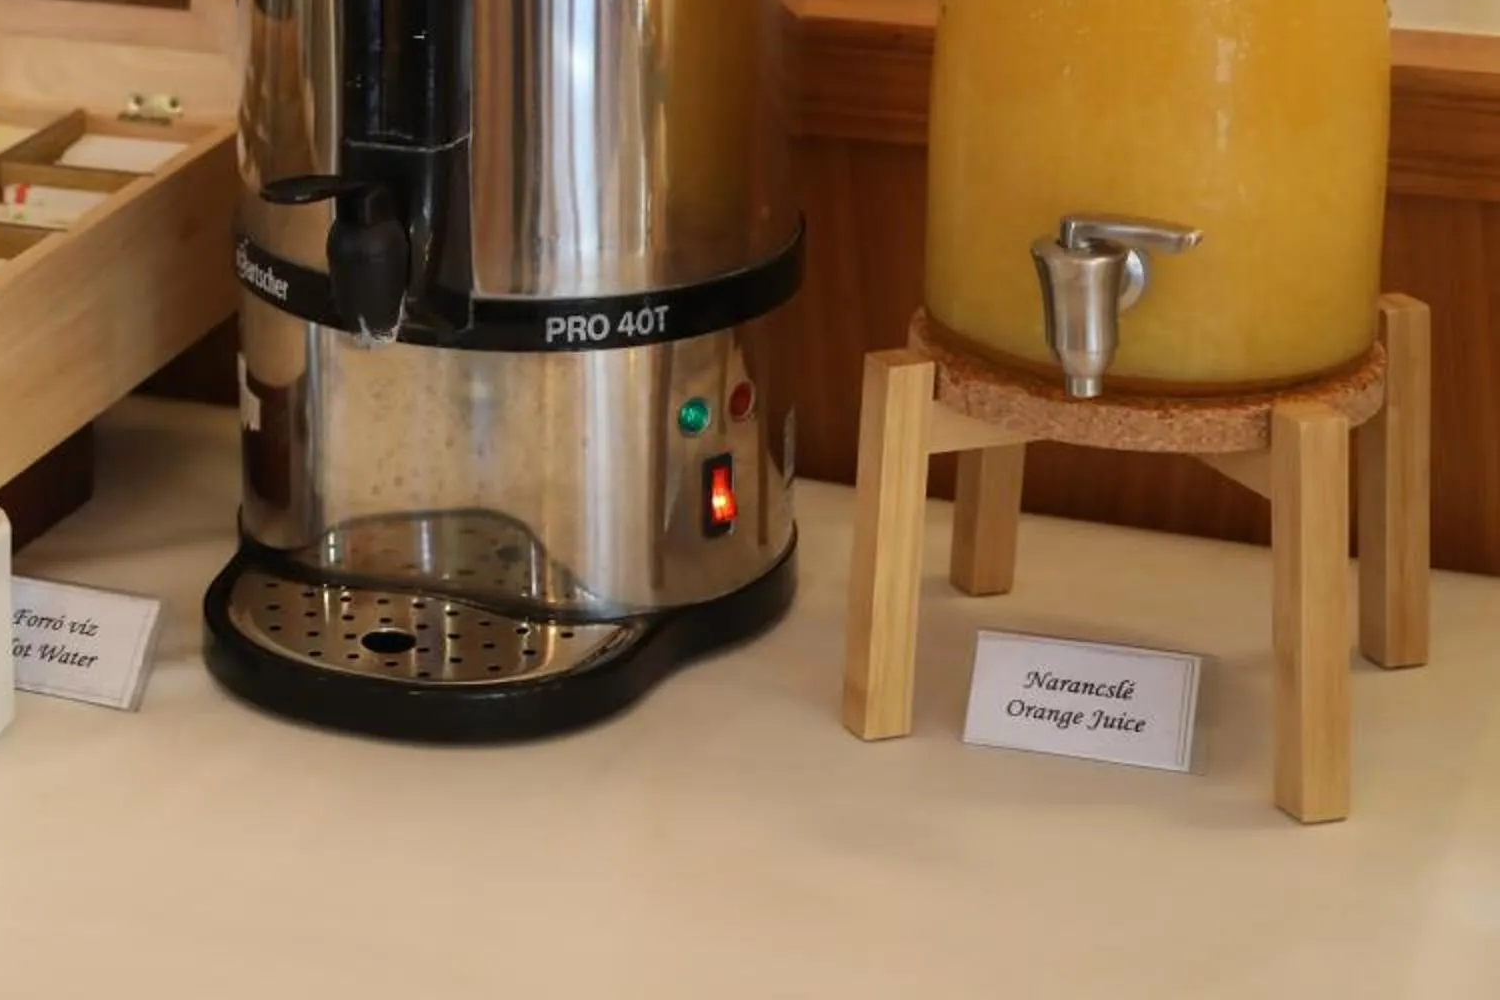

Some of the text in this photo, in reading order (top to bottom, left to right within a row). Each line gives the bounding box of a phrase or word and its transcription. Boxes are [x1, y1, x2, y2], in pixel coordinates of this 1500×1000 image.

[545, 305, 669, 343] PRO 40T
[12, 608, 100, 637] Forró víz
[12, 637, 99, 668] ot Water
[1023, 671, 1137, 700] Narancslé
[1006, 699, 1147, 733] Orange Juice
